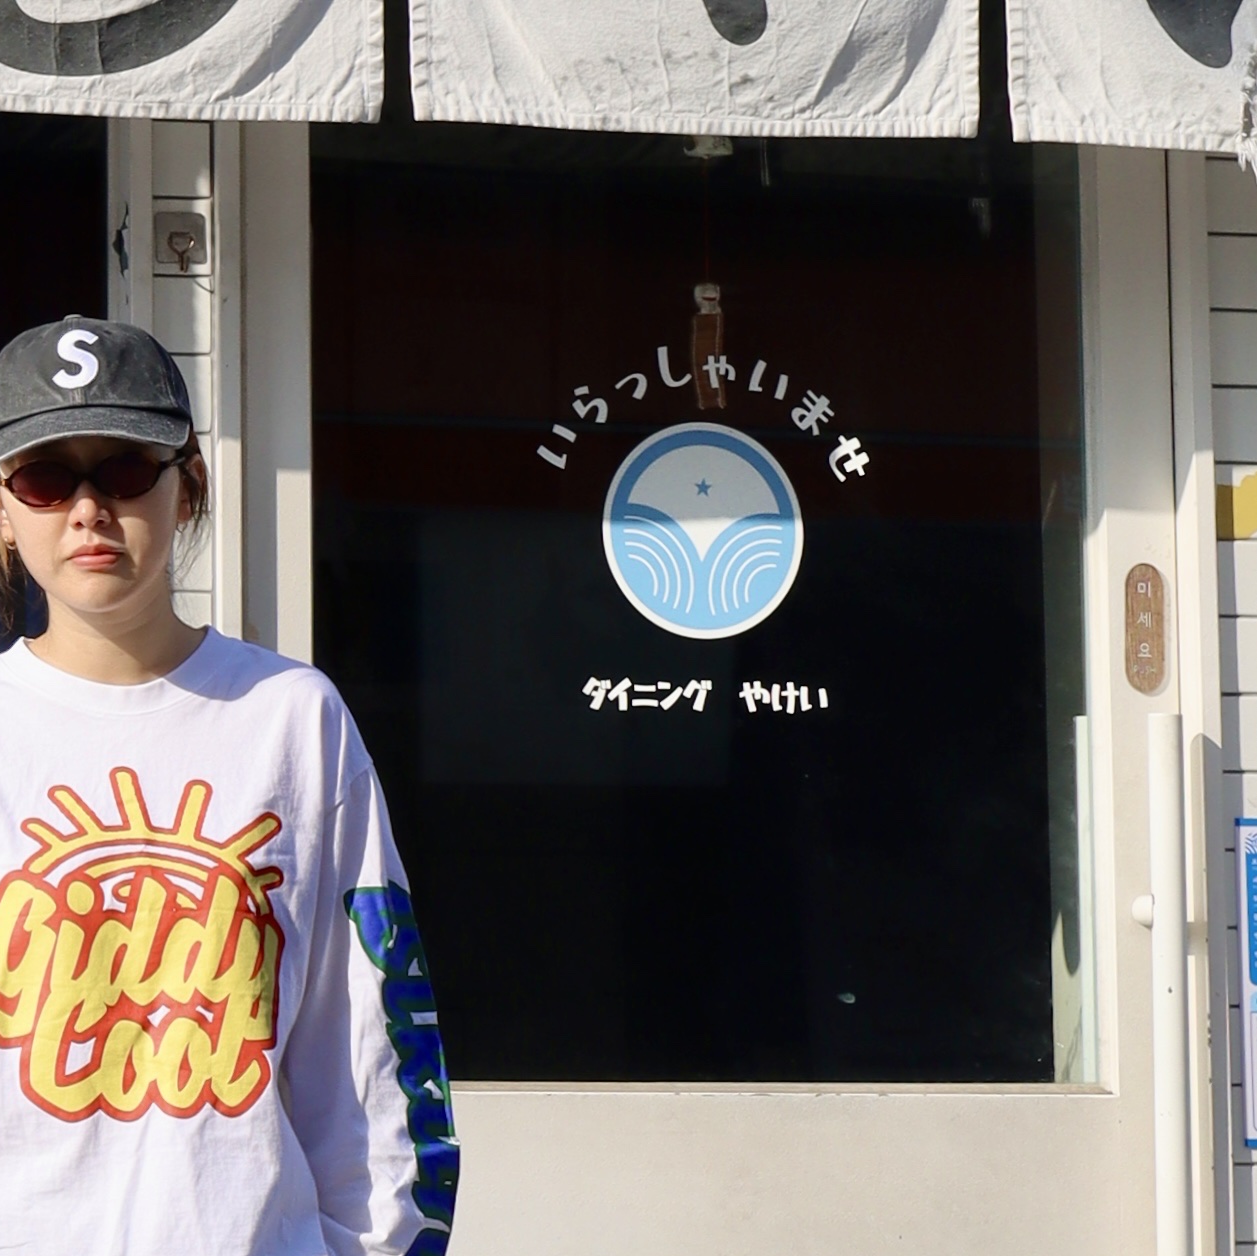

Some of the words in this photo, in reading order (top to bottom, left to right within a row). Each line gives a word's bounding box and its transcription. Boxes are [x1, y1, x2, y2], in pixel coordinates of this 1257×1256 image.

[52, 329, 99, 390] S
[537, 346, 870, 482] いらっしゃいませ
[1137, 582, 1152, 658] 미세요
[582, 677, 712, 712] ダイニング
[739, 680, 829, 714] やけい
[24, 992, 268, 1117] Cool
